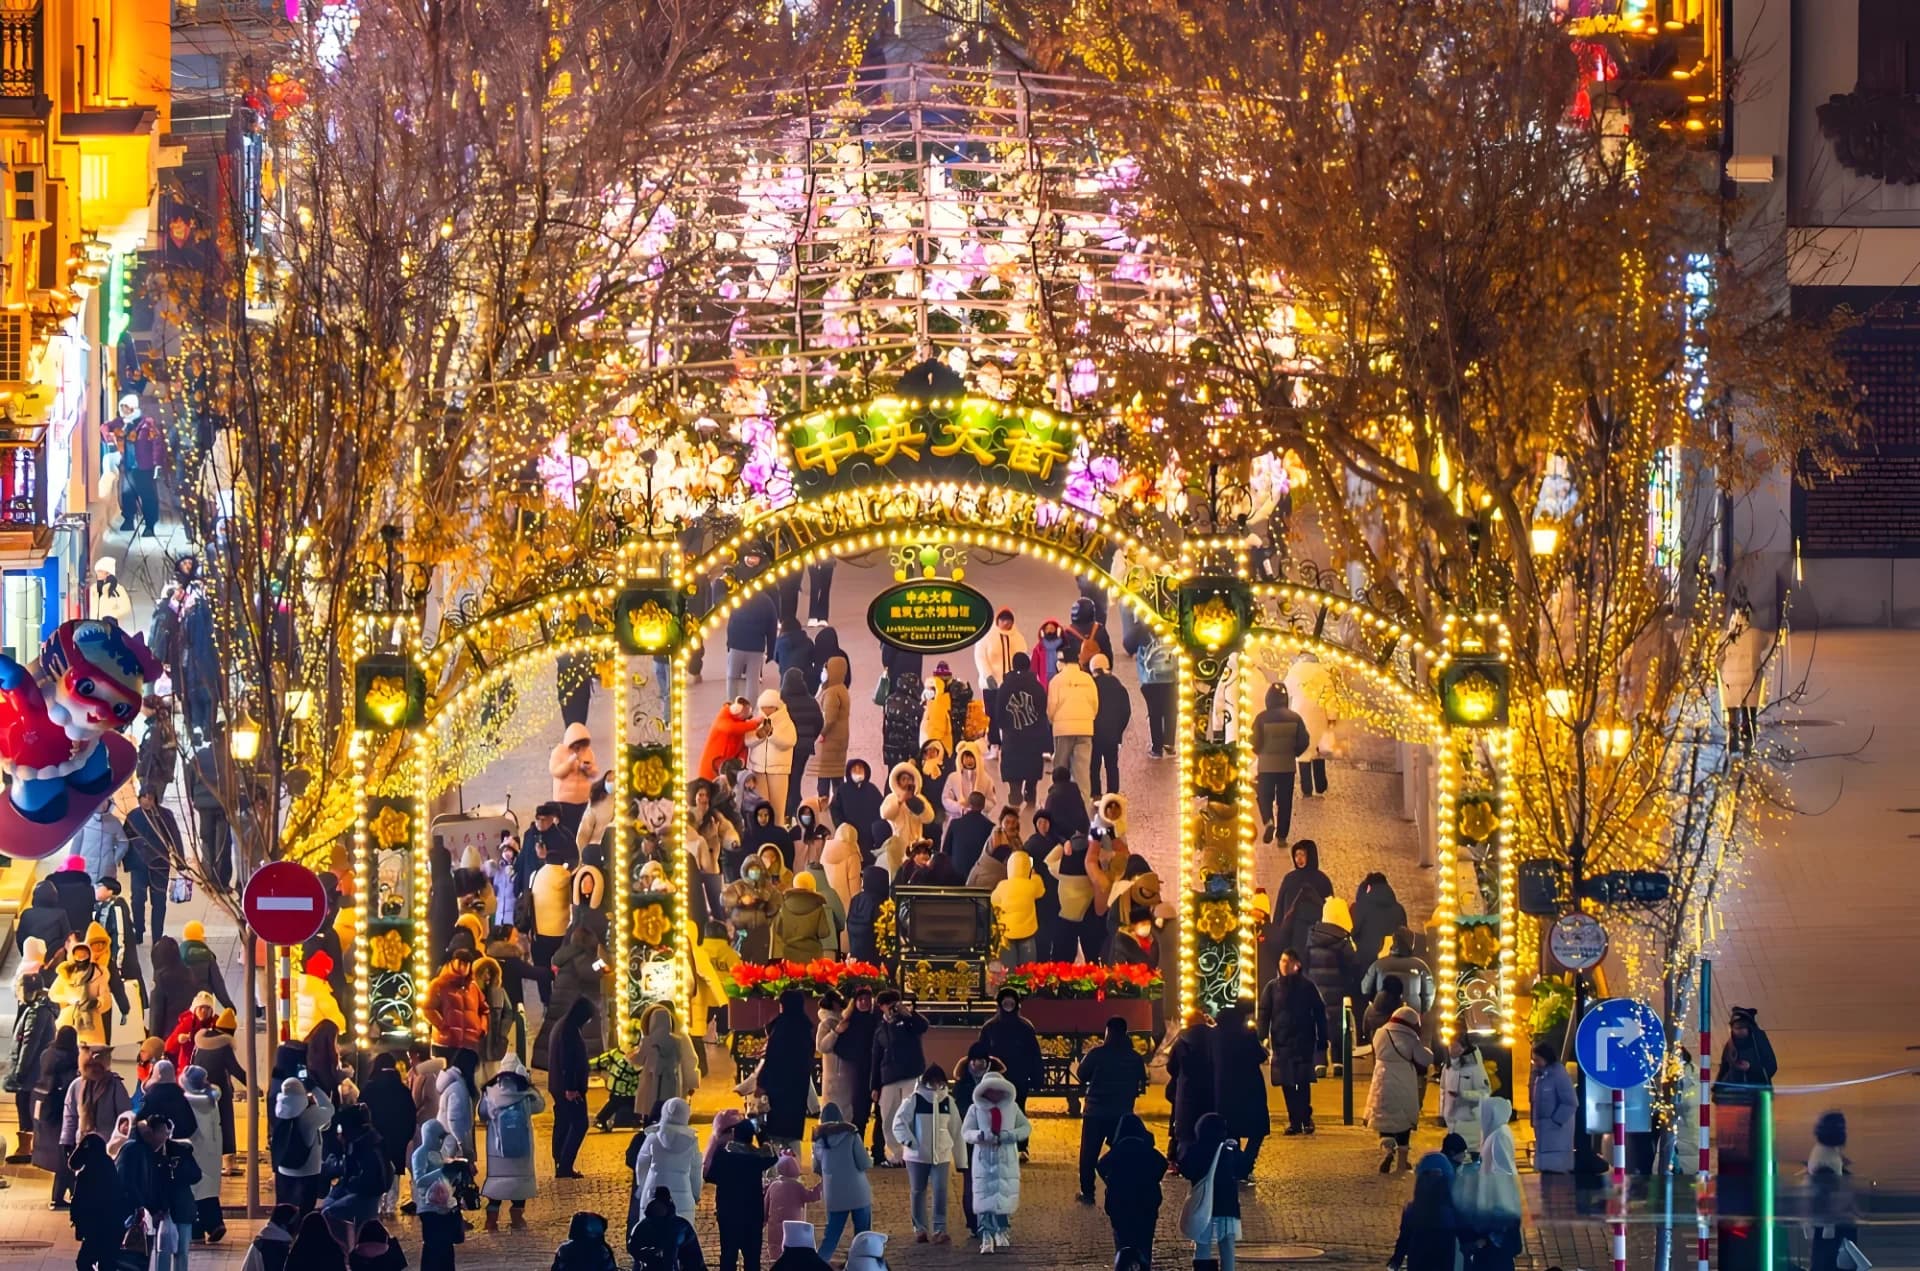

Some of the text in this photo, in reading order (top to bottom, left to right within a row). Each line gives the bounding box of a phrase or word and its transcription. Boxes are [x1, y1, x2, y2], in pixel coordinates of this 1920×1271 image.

[795, 422, 1068, 479] 中央大街
[906, 591, 952, 603] 中央大街
[1005, 691, 1039, 730] NY
